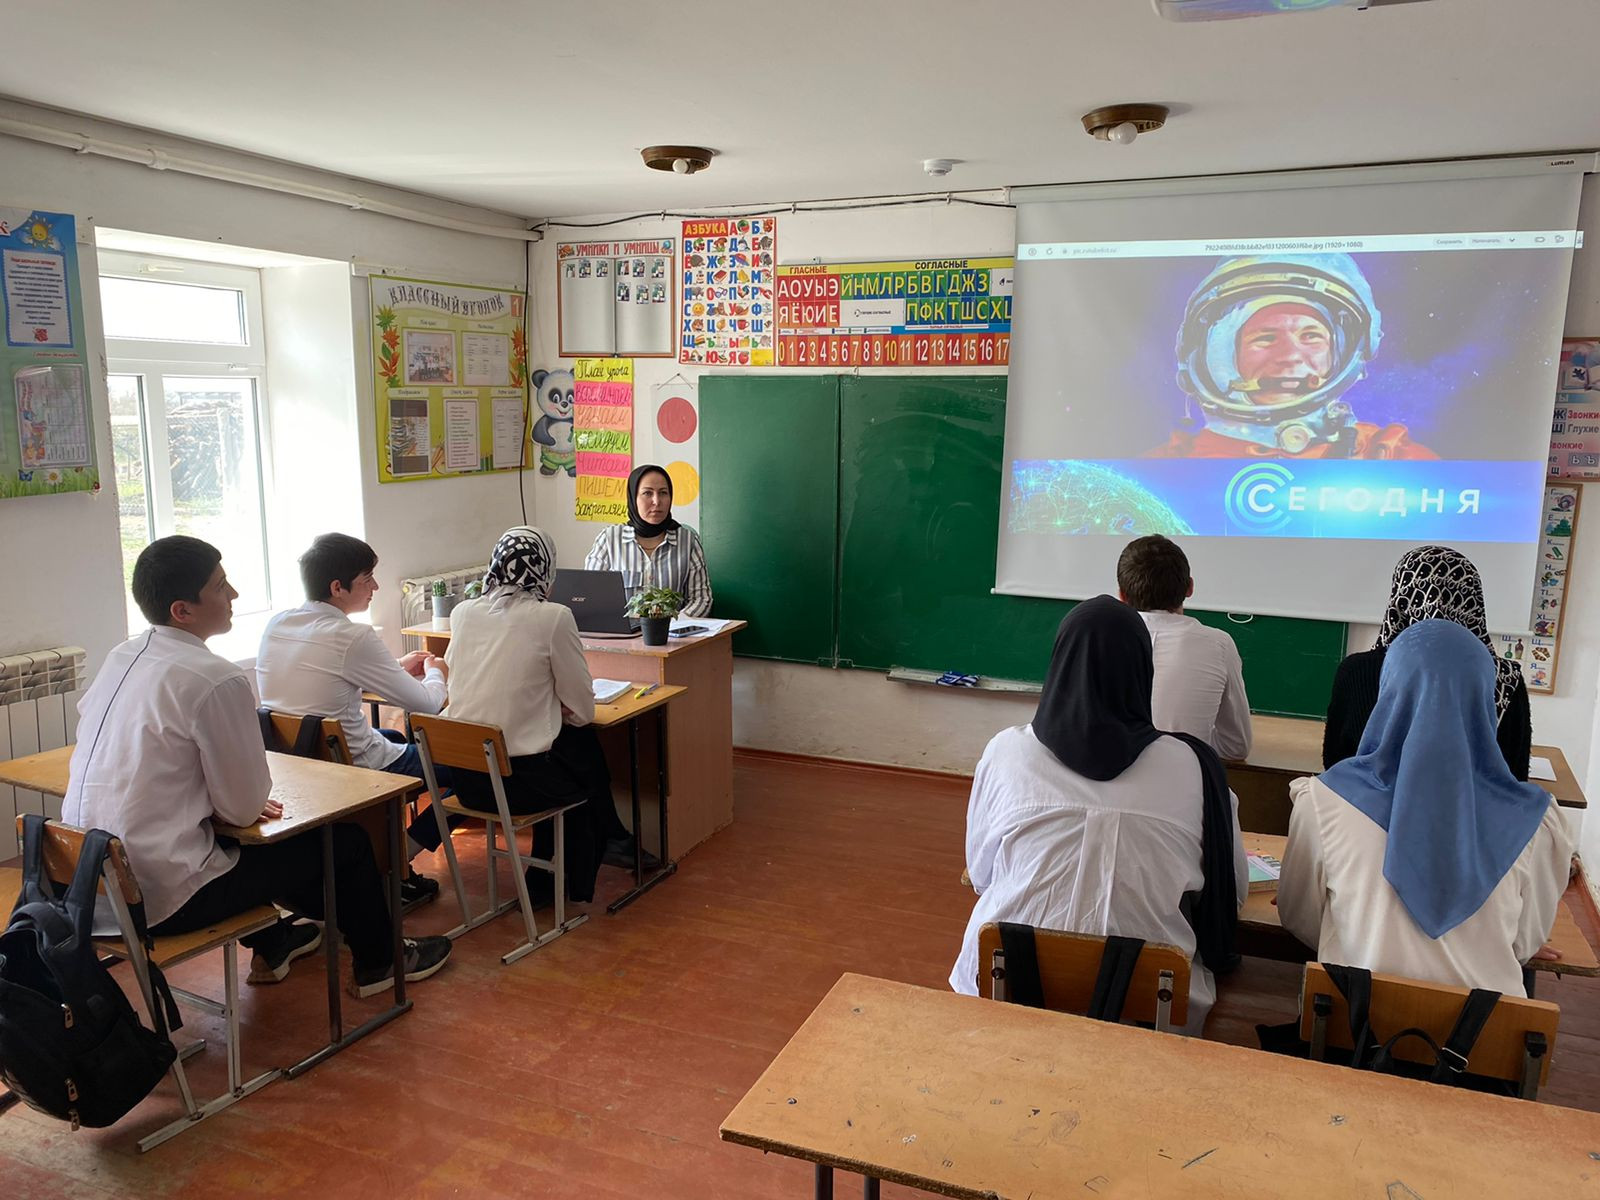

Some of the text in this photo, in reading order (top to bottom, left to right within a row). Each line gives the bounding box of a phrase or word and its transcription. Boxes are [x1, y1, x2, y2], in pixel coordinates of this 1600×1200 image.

[685, 223, 727, 235] АЗБУКА
[576, 241, 660, 256] УМНИКИ И УМНИЦЫ
[789, 266, 828, 274] ГЛАСНЫЕ
[915, 260, 968, 270] СОГЛАСНЫЕ
[388, 285, 504, 316] КЛАССНЫЙ УГОЛОК
[779, 339, 1010, 361] 0 1 2 3 4 5 6 7 8 9 10 11 12 13 14 15 16 17
[1567, 410, 1600, 420] Звонки
[1567, 424, 1600, 434] Глухие
[1550, 441, 1583, 449] вонкие
[578, 477, 626, 498] ПИШЕМ
[1248, 483, 1481, 517] СЕГОДНЯ
